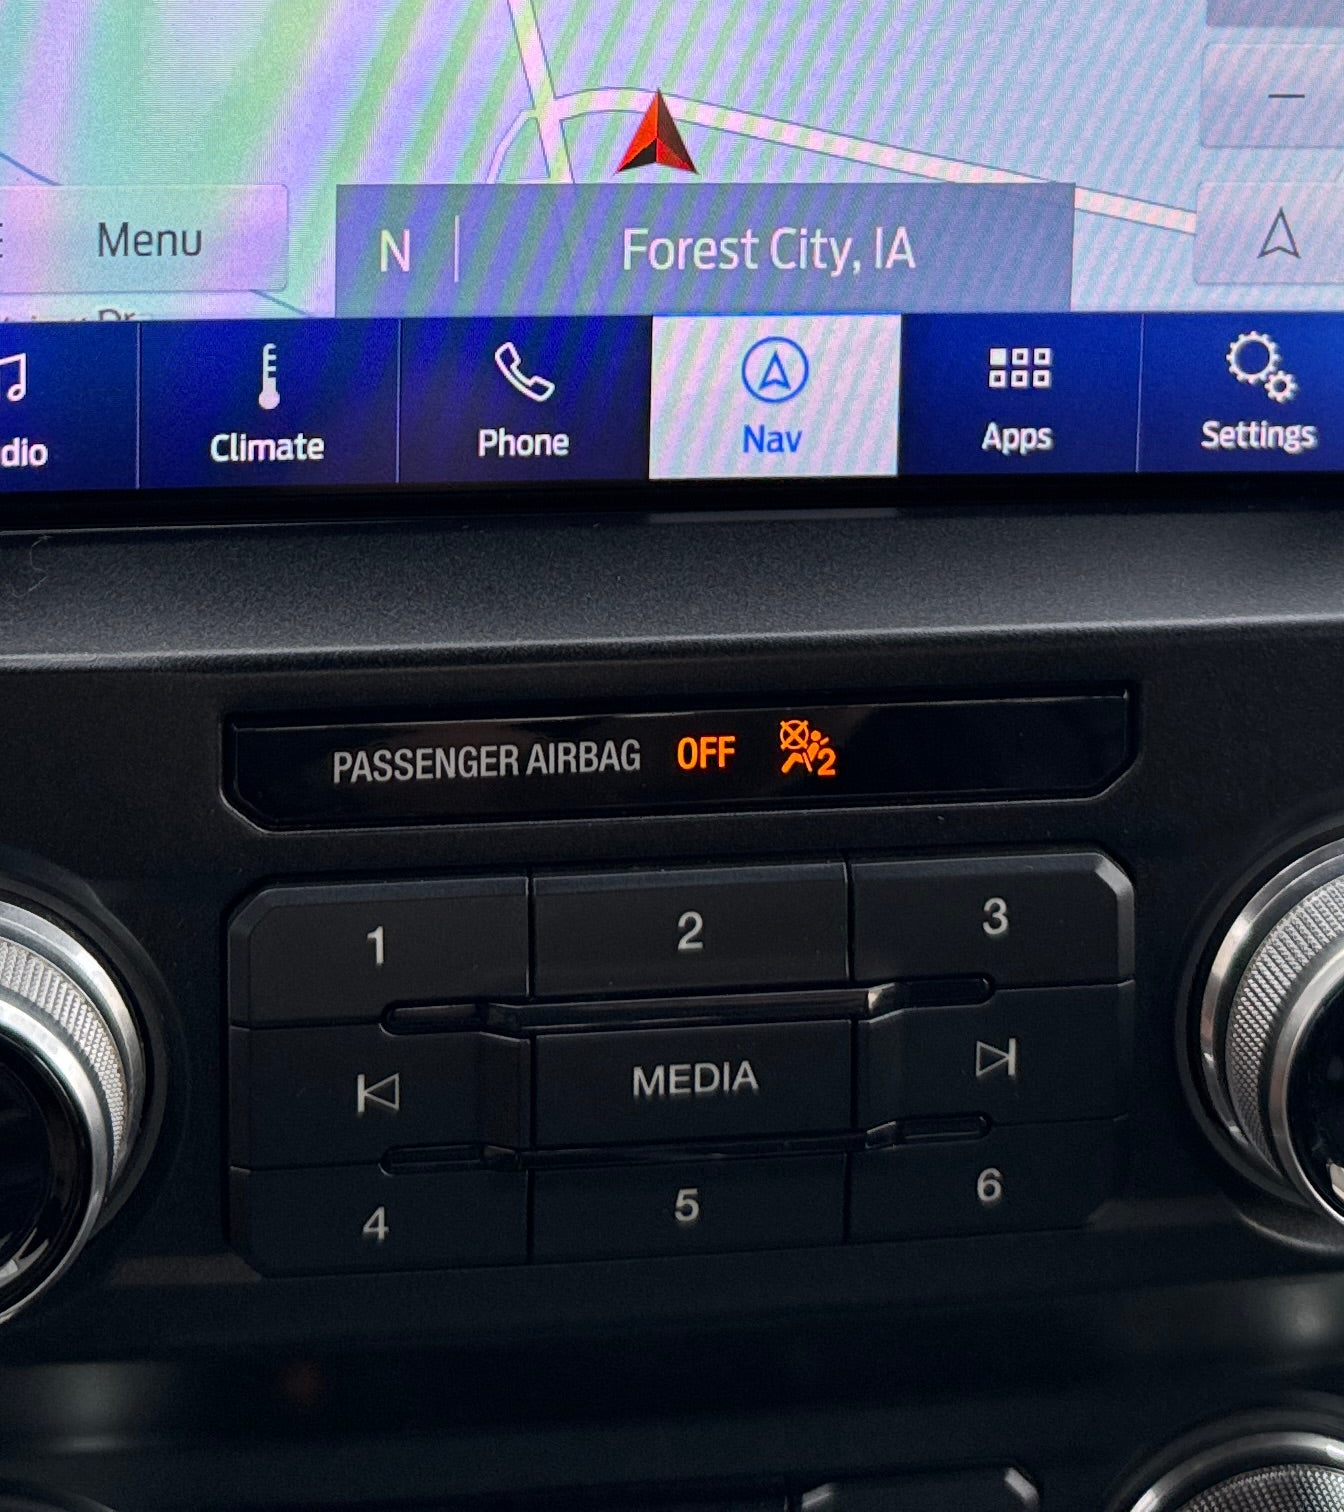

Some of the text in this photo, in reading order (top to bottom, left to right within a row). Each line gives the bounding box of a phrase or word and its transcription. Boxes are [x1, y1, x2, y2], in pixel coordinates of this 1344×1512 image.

[97, 221, 204, 258] Menu
[379, 229, 411, 273] N
[621, 225, 916, 278] Forest City, IA
[209, 432, 325, 463] Climate
[478, 427, 569, 460] Phone
[742, 424, 803, 454] Nav
[982, 421, 1053, 455] Apps
[1201, 418, 1318, 452] Settings
[331, 737, 642, 784] PASSENGER AIRBAG
[676, 735, 737, 771] OFF
[678, 910, 705, 951] 2
[981, 898, 1010, 937] 3
[368, 926, 387, 965] 1
[632, 1061, 760, 1097] MEDIA
[975, 1168, 1003, 1205] 6
[363, 1208, 390, 1242] 4
[675, 1188, 701, 1225] 5
